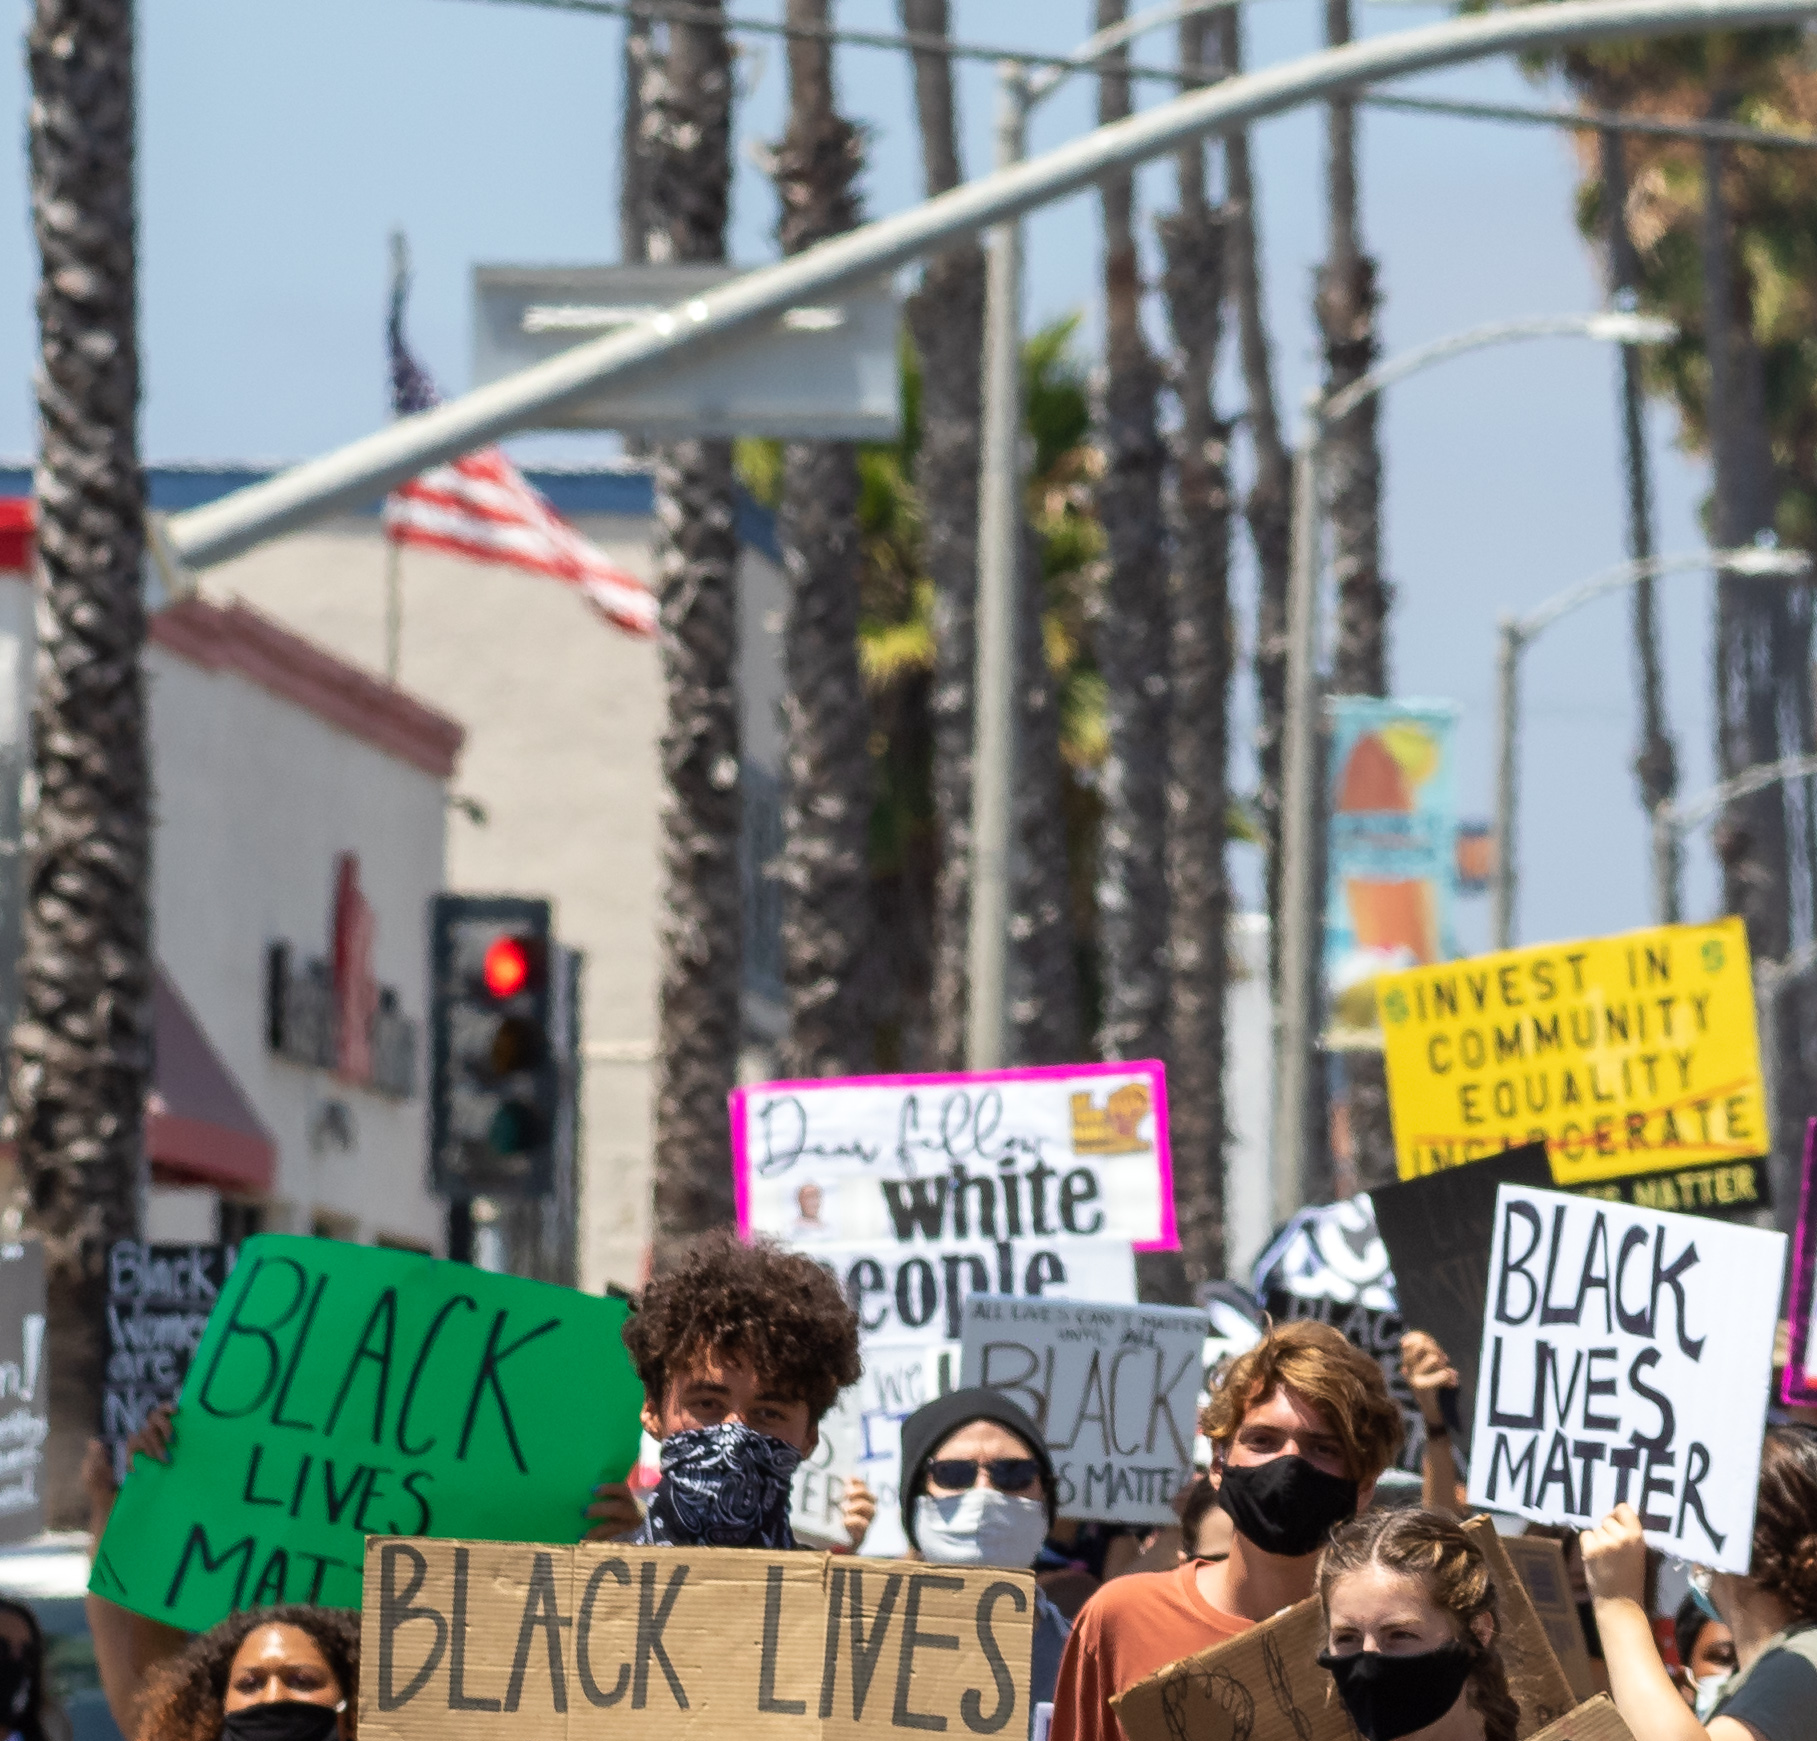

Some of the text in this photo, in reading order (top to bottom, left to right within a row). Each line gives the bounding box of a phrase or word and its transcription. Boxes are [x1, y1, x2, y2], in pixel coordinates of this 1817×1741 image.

[1413, 944, 1673, 1023] INVEST IN
[1427, 993, 1712, 1075] COMMUNITY
[1458, 1049, 1696, 1128] EQUALITY
[881, 1157, 1105, 1242] white
[826, 1242, 1067, 1340] eople
[1493, 1199, 1707, 1363] BLACK
[200, 1256, 562, 1476] BLACK
[980, 1340, 1197, 1472] BLACK
[1486, 1335, 1679, 1453] LIVES
[243, 1442, 432, 1538] LIVES
[1484, 1431, 1728, 1555] MATTER
[377, 1543, 691, 1714] BLACK
[758, 1565, 1028, 1735] LIVES
